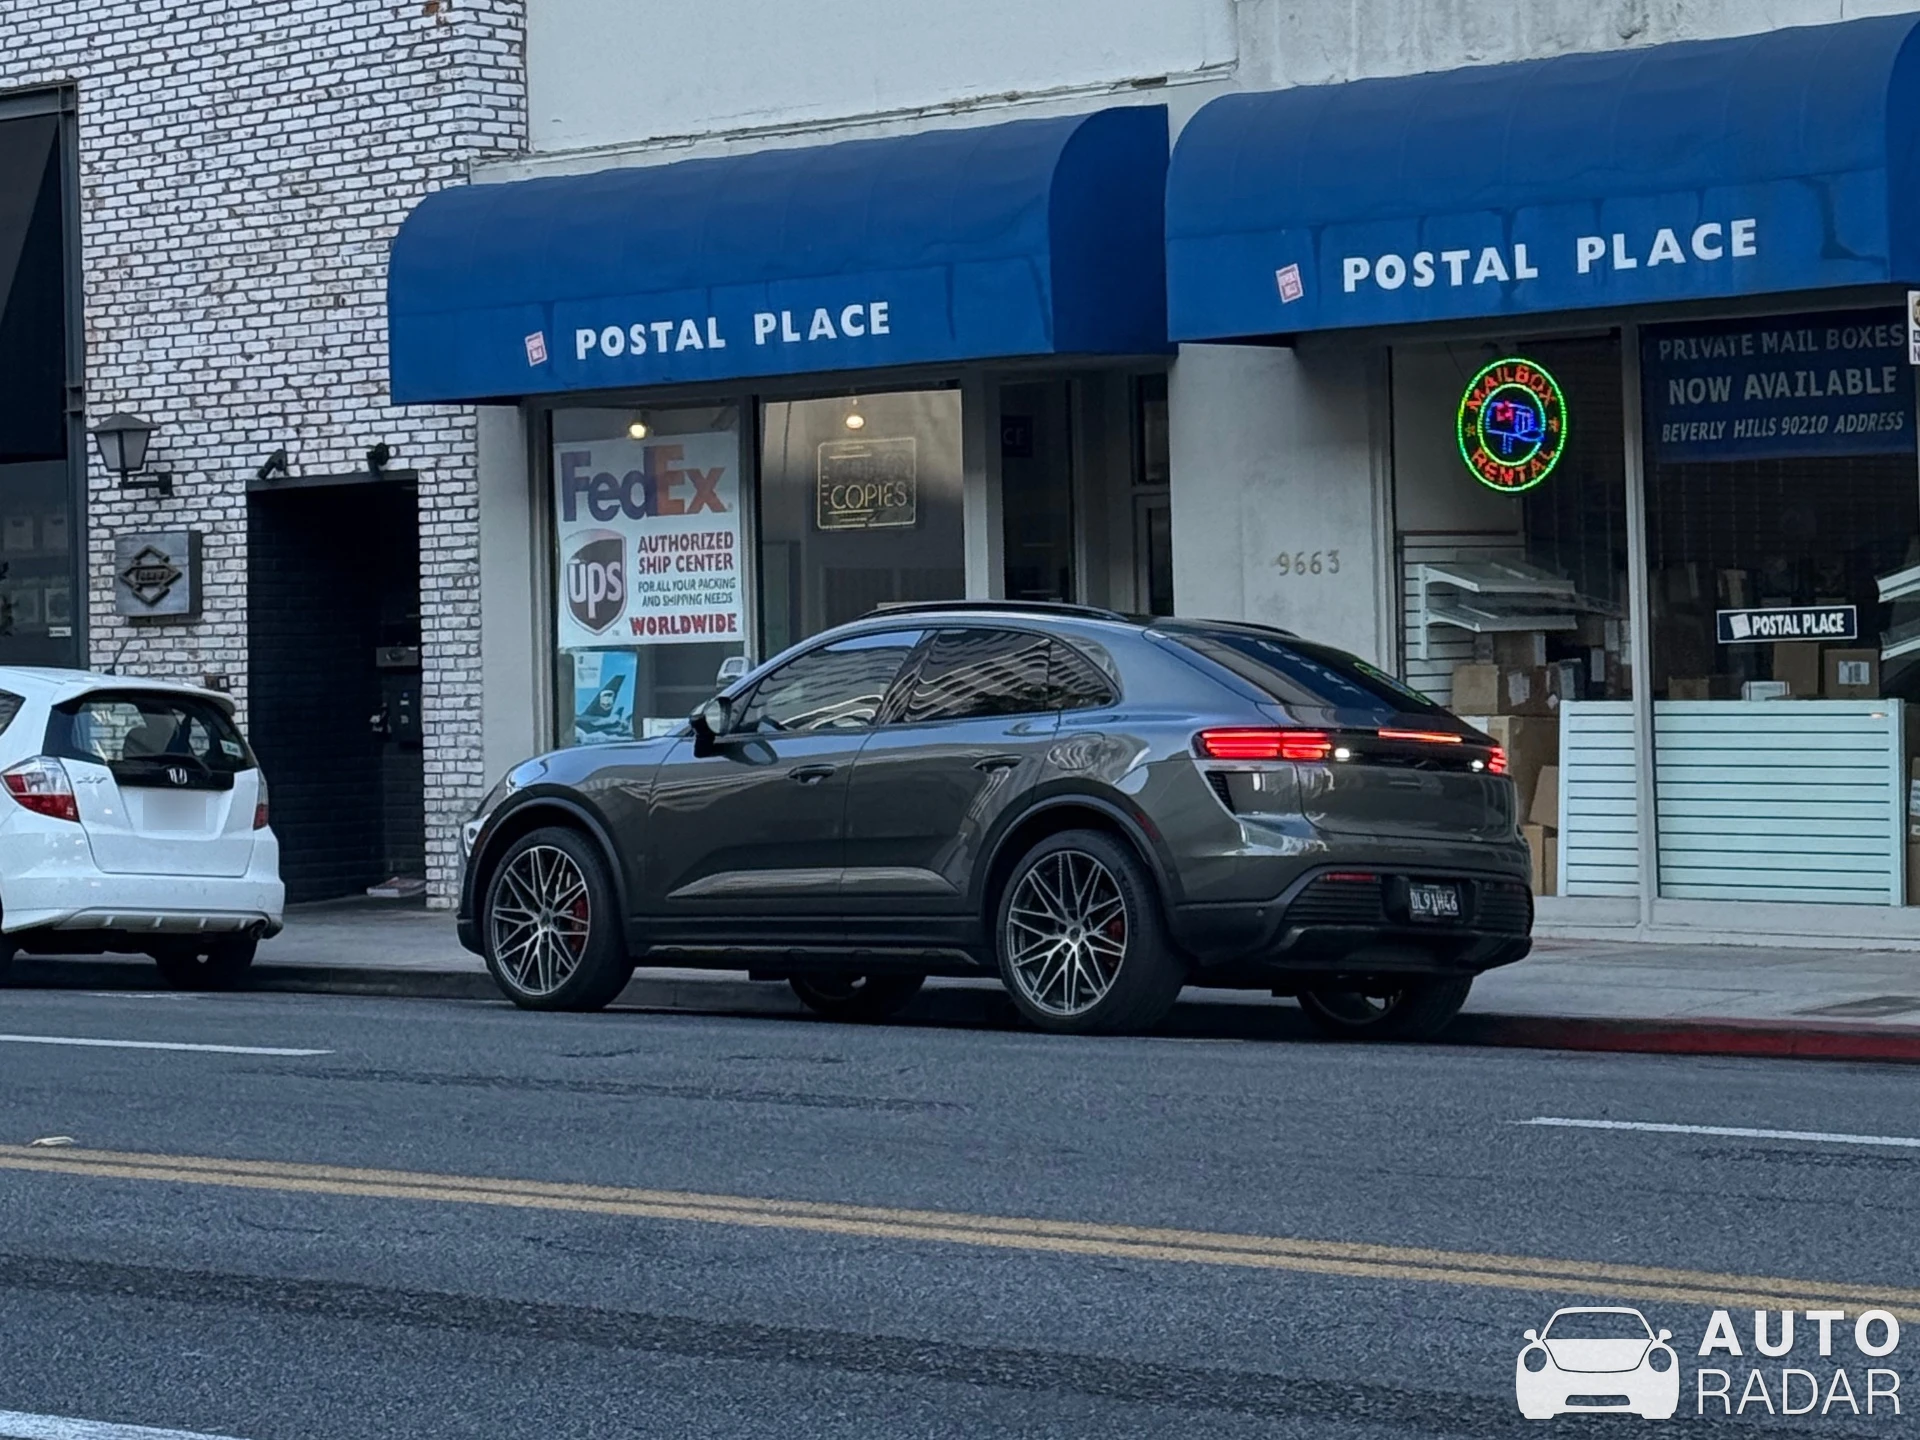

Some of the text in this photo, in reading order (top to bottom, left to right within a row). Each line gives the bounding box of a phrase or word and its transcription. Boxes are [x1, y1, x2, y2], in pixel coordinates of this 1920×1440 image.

[1343, 218, 1756, 292] POSTAL PLACE
[575, 301, 890, 360] POSTAL PLACE
[1659, 333, 1754, 361] PRIVATE
[1761, 329, 1818, 354] MAIL
[1826, 323, 1905, 350] BOXES
[1669, 366, 1897, 405] NOW AVAILABLE
[1662, 411, 1905, 442] BEVERLY HILLS 90210 ADDRESS
[1471, 447, 1555, 485] RENTAL
[560, 444, 728, 522] FedEx
[830, 482, 908, 509] COPIES
[637, 531, 734, 554] AUTHORIZED
[638, 552, 734, 575] SHIP CENTER
[1277, 549, 1340, 576] 9663
[638, 577, 736, 593] FOR ALL YOUR PACKING
[642, 592, 733, 607] AND SHIPPING NEEDS
[629, 613, 737, 636] WORLDWIDE
[1752, 612, 1845, 635] POSTAL PLACE
